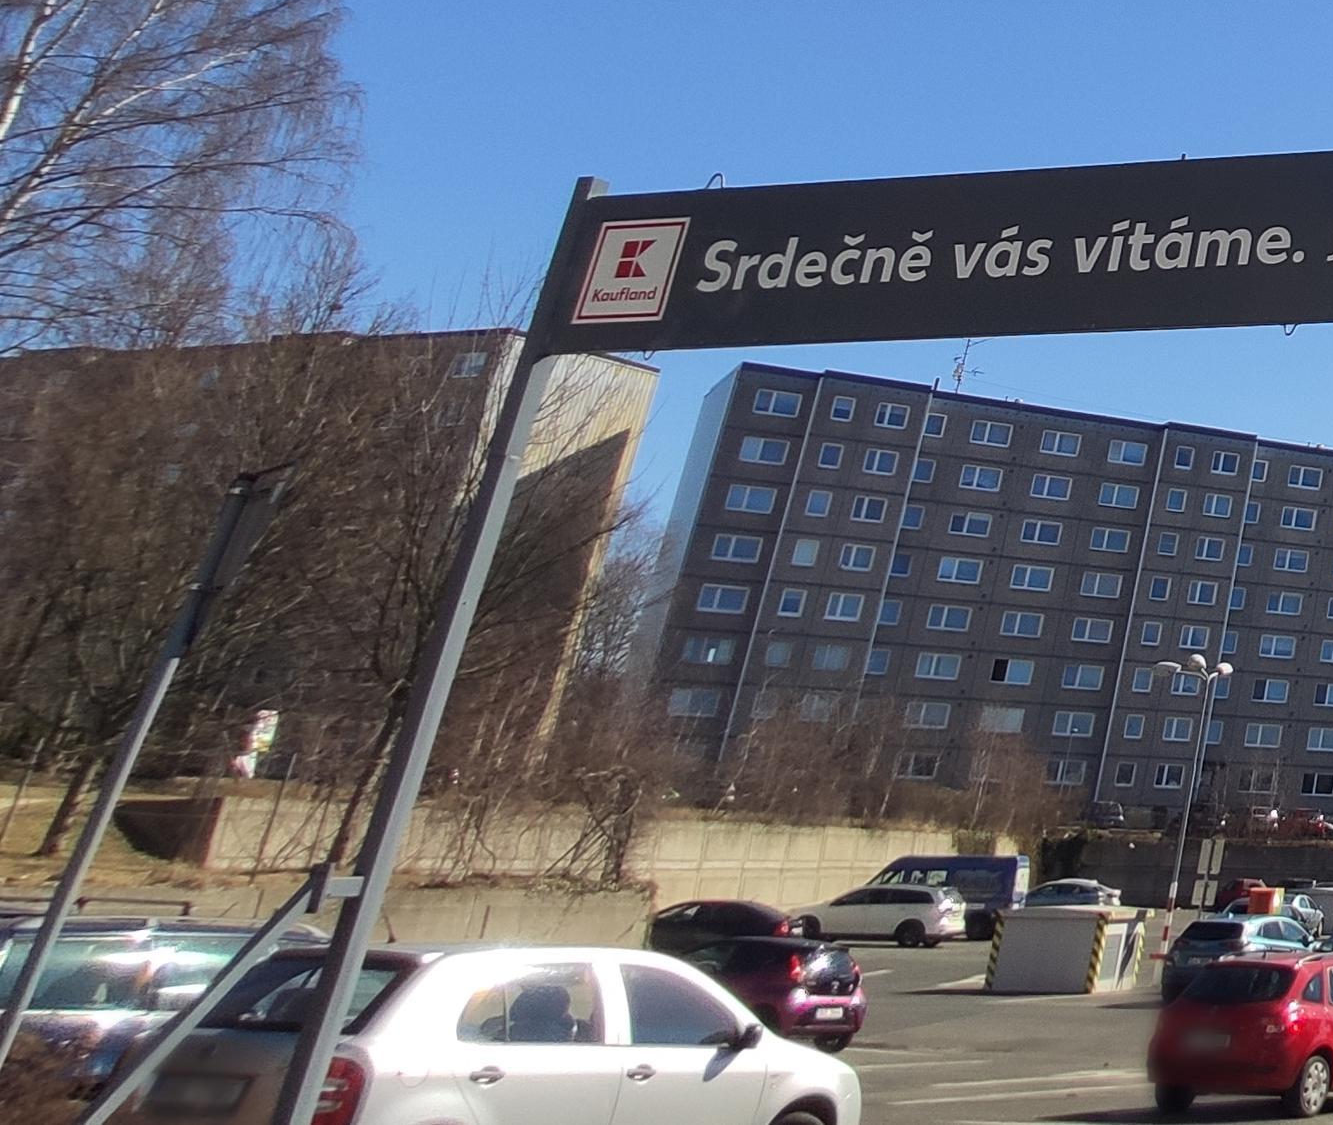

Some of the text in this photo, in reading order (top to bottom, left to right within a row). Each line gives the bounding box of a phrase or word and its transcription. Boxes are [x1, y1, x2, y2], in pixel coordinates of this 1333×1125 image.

[695, 229, 934, 293] Srdečně
[954, 225, 1054, 279] vás
[1074, 216, 1305, 273] vítáme.
[592, 285, 658, 303] Kaufland
